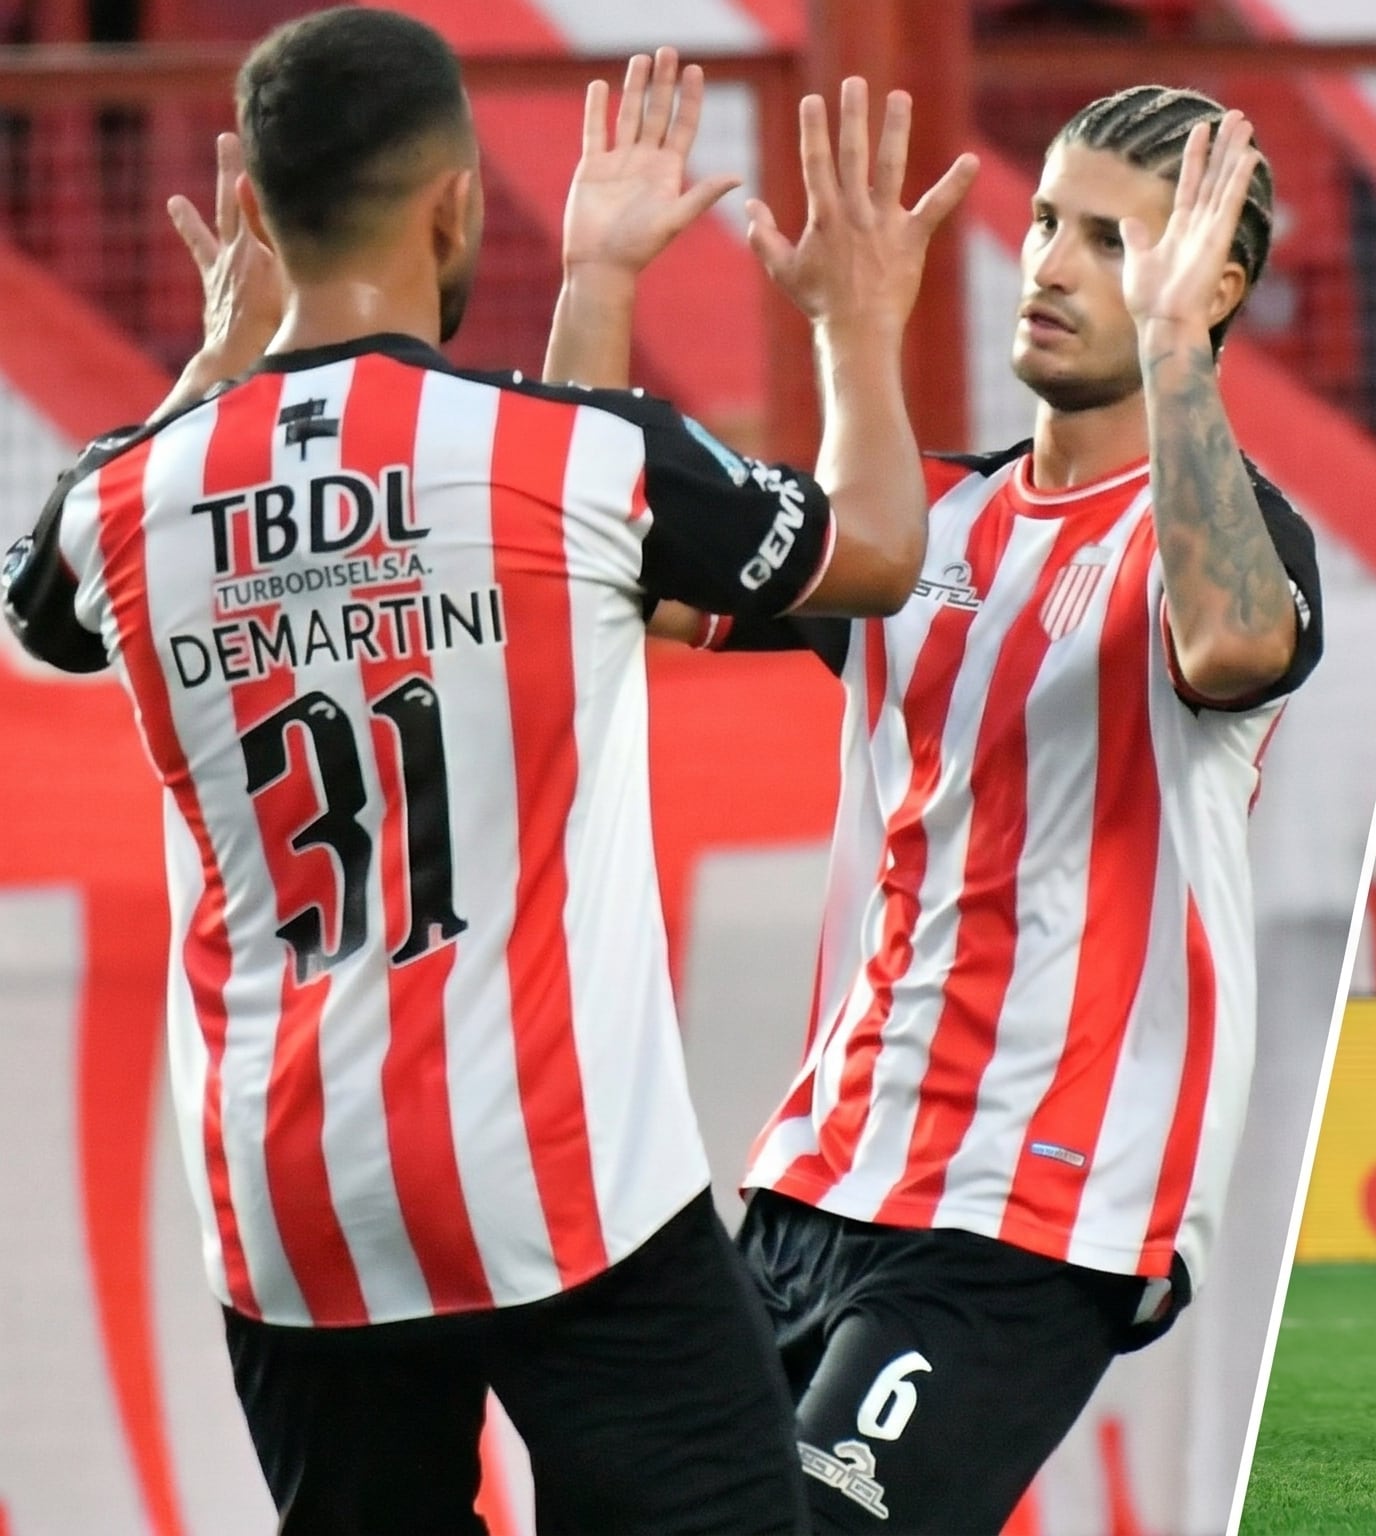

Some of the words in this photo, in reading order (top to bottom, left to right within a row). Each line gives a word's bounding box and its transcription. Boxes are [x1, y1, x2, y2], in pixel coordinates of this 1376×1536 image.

[190, 470, 432, 574] TBDL
[217, 562, 377, 610] TURBODISEL
[382, 553, 434, 580] S.A.
[169, 589, 504, 690] DEMARTINI
[240, 677, 468, 984] 31
[857, 1350, 933, 1441] 6
